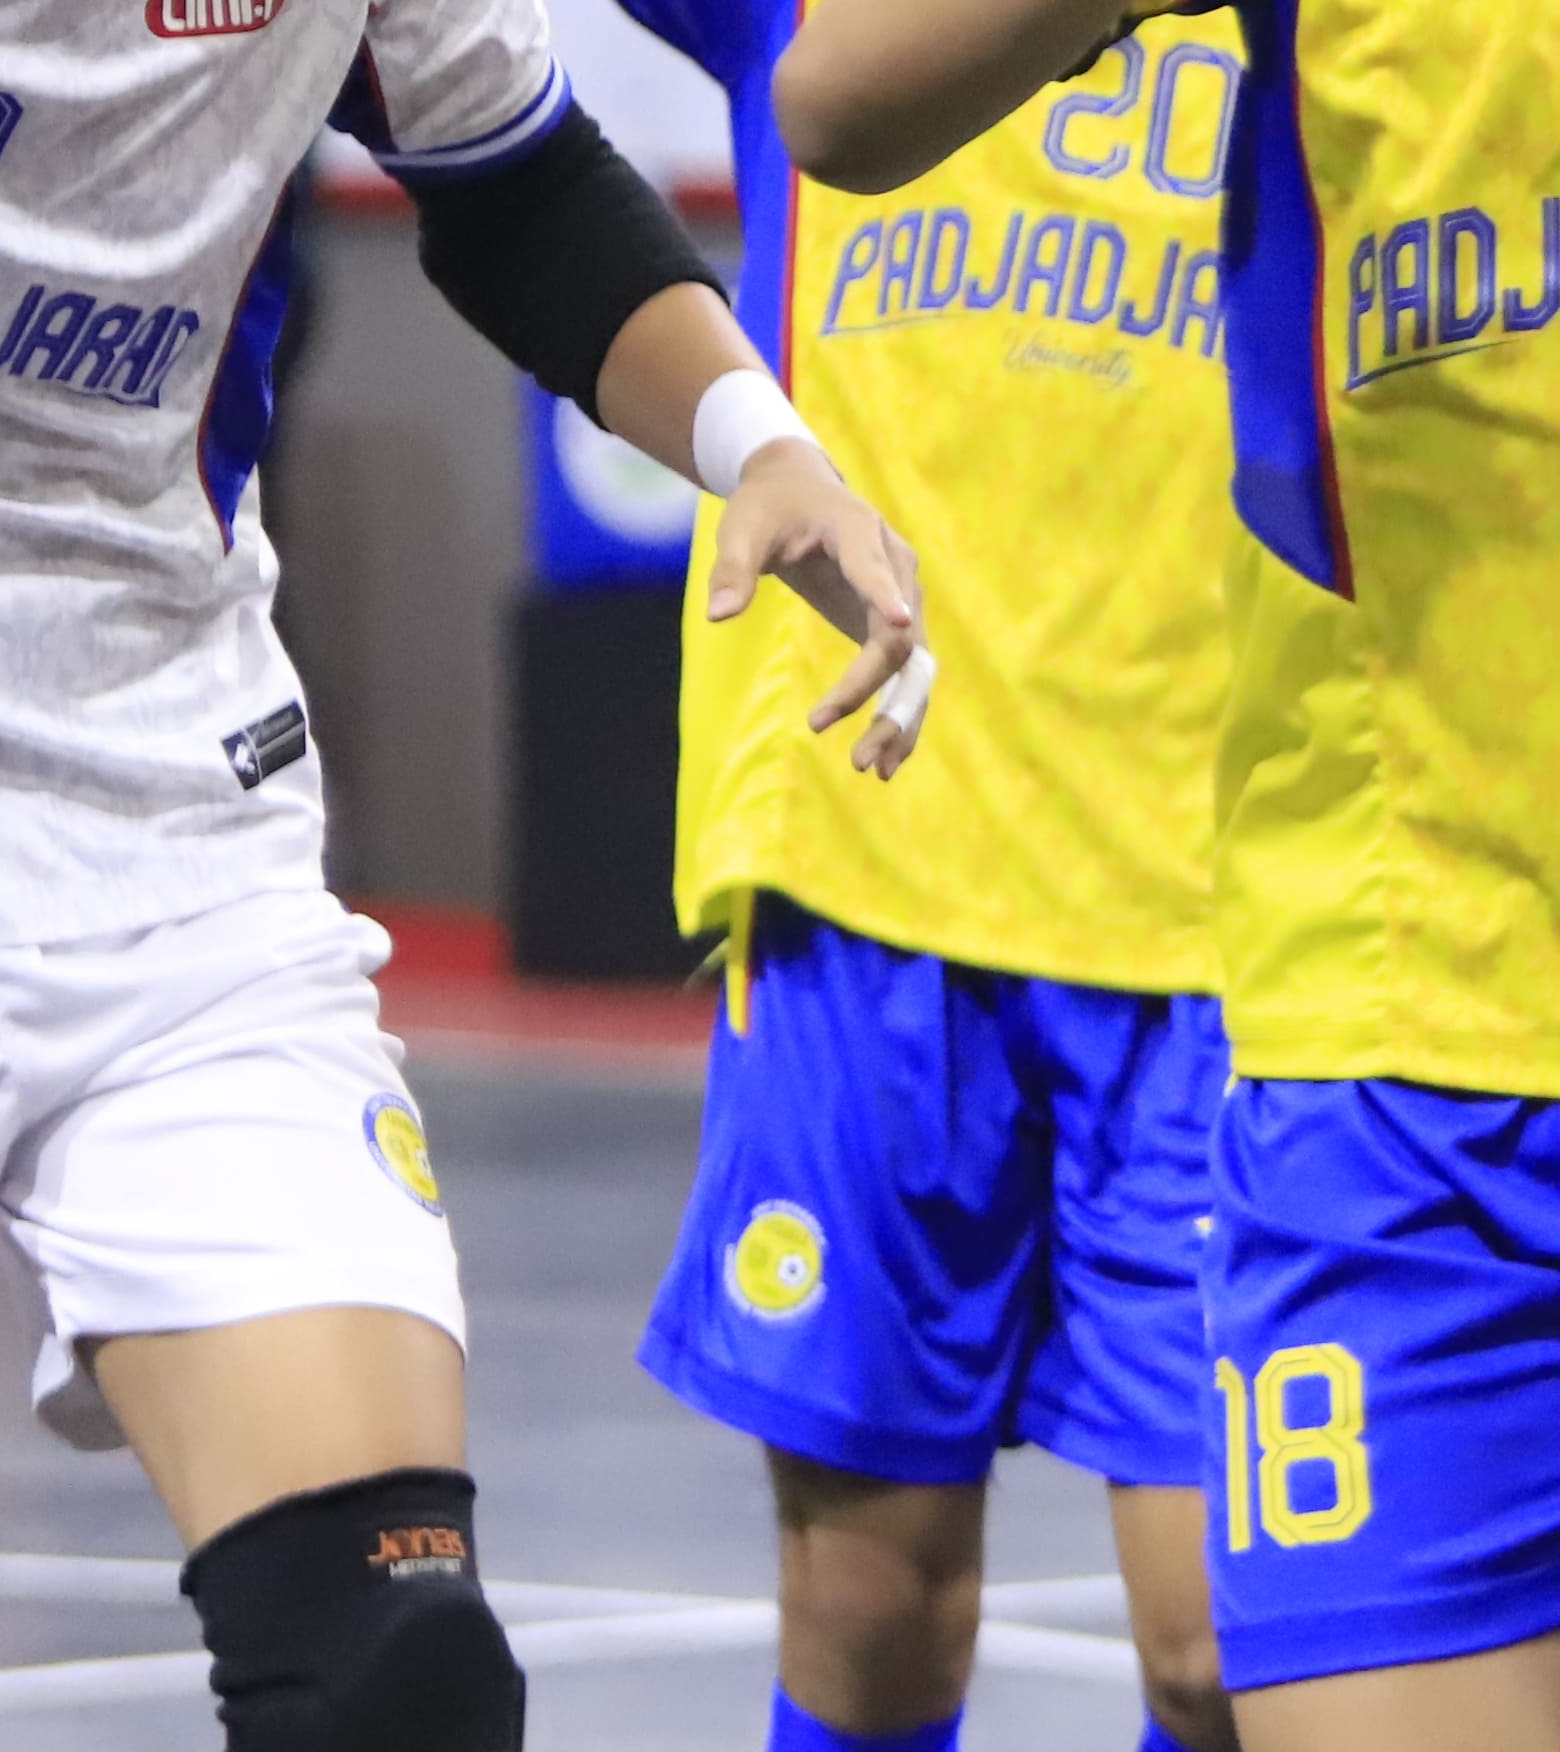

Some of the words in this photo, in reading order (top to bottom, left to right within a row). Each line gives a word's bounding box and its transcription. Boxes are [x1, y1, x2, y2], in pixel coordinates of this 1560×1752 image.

[1043, 34, 1241, 199] 20
[820, 207, 1225, 360] PADJADJA
[1214, 1342, 1373, 1552] 18
